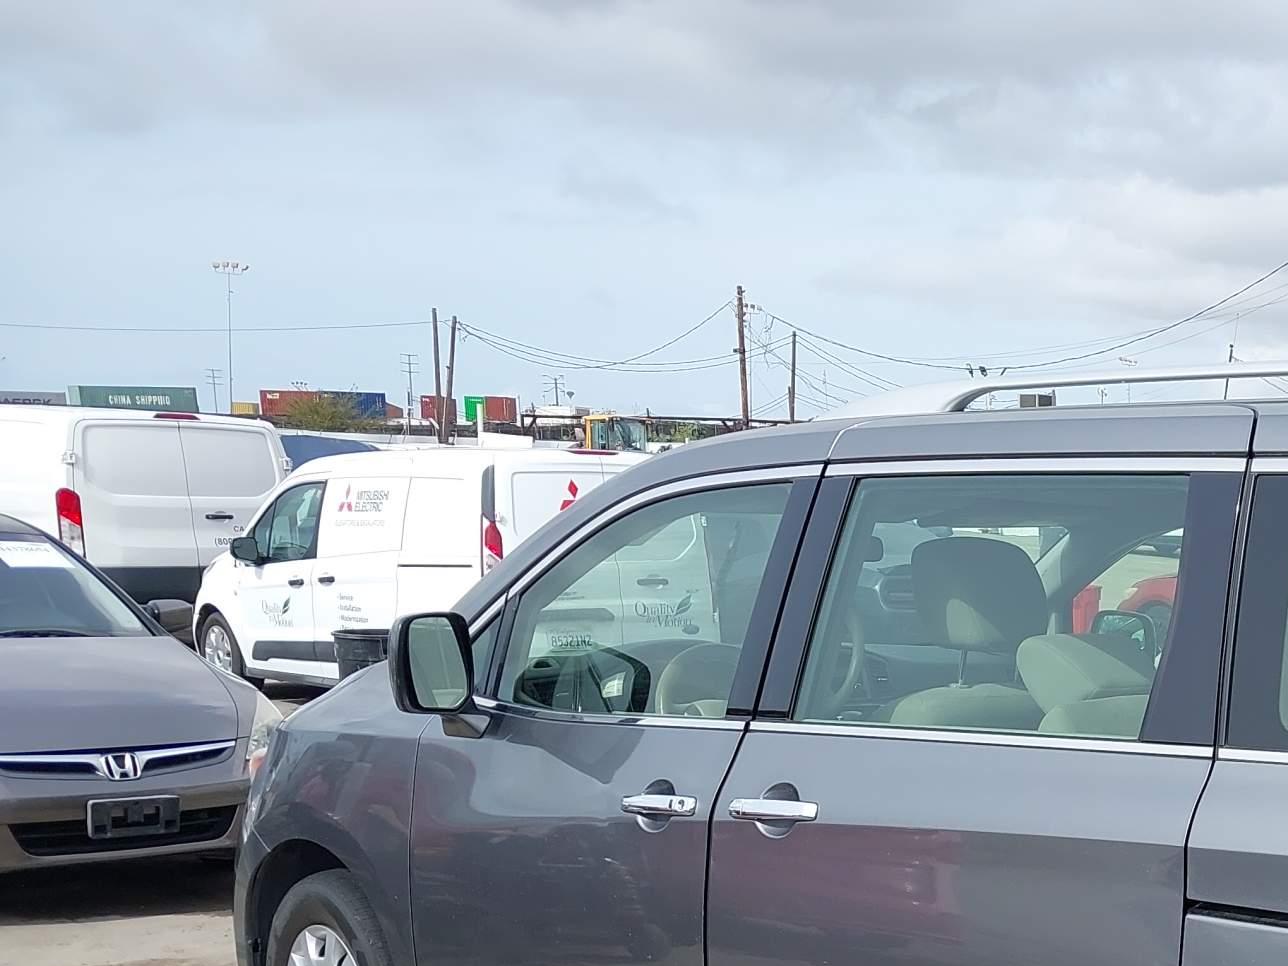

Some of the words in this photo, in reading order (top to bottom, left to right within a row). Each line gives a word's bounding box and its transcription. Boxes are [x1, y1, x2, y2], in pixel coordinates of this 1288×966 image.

[108, 394, 132, 406] CHINA
[634, 601, 676, 618] Quality
[656, 614, 693, 628] Motion
